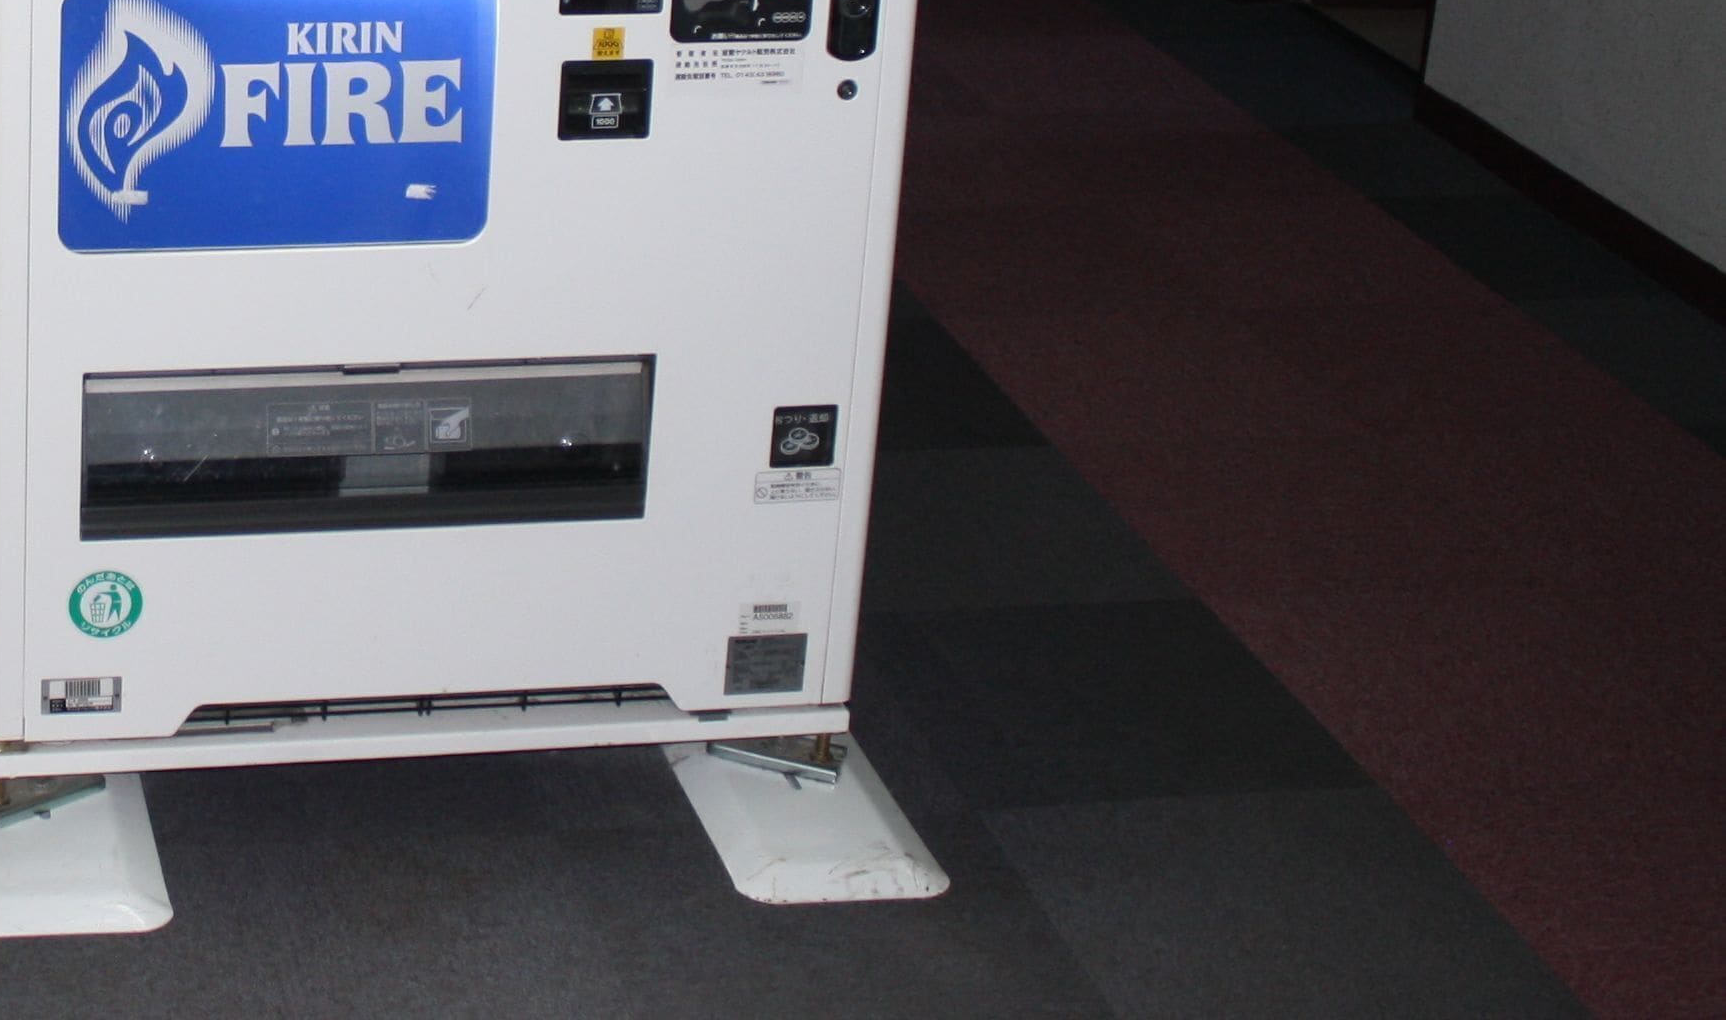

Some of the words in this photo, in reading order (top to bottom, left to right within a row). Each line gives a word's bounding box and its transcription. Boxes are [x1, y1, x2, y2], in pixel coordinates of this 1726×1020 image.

[287, 20, 403, 54] KIRIN
[220, 59, 463, 147] FIRE
[595, 117, 616, 126] 1000
